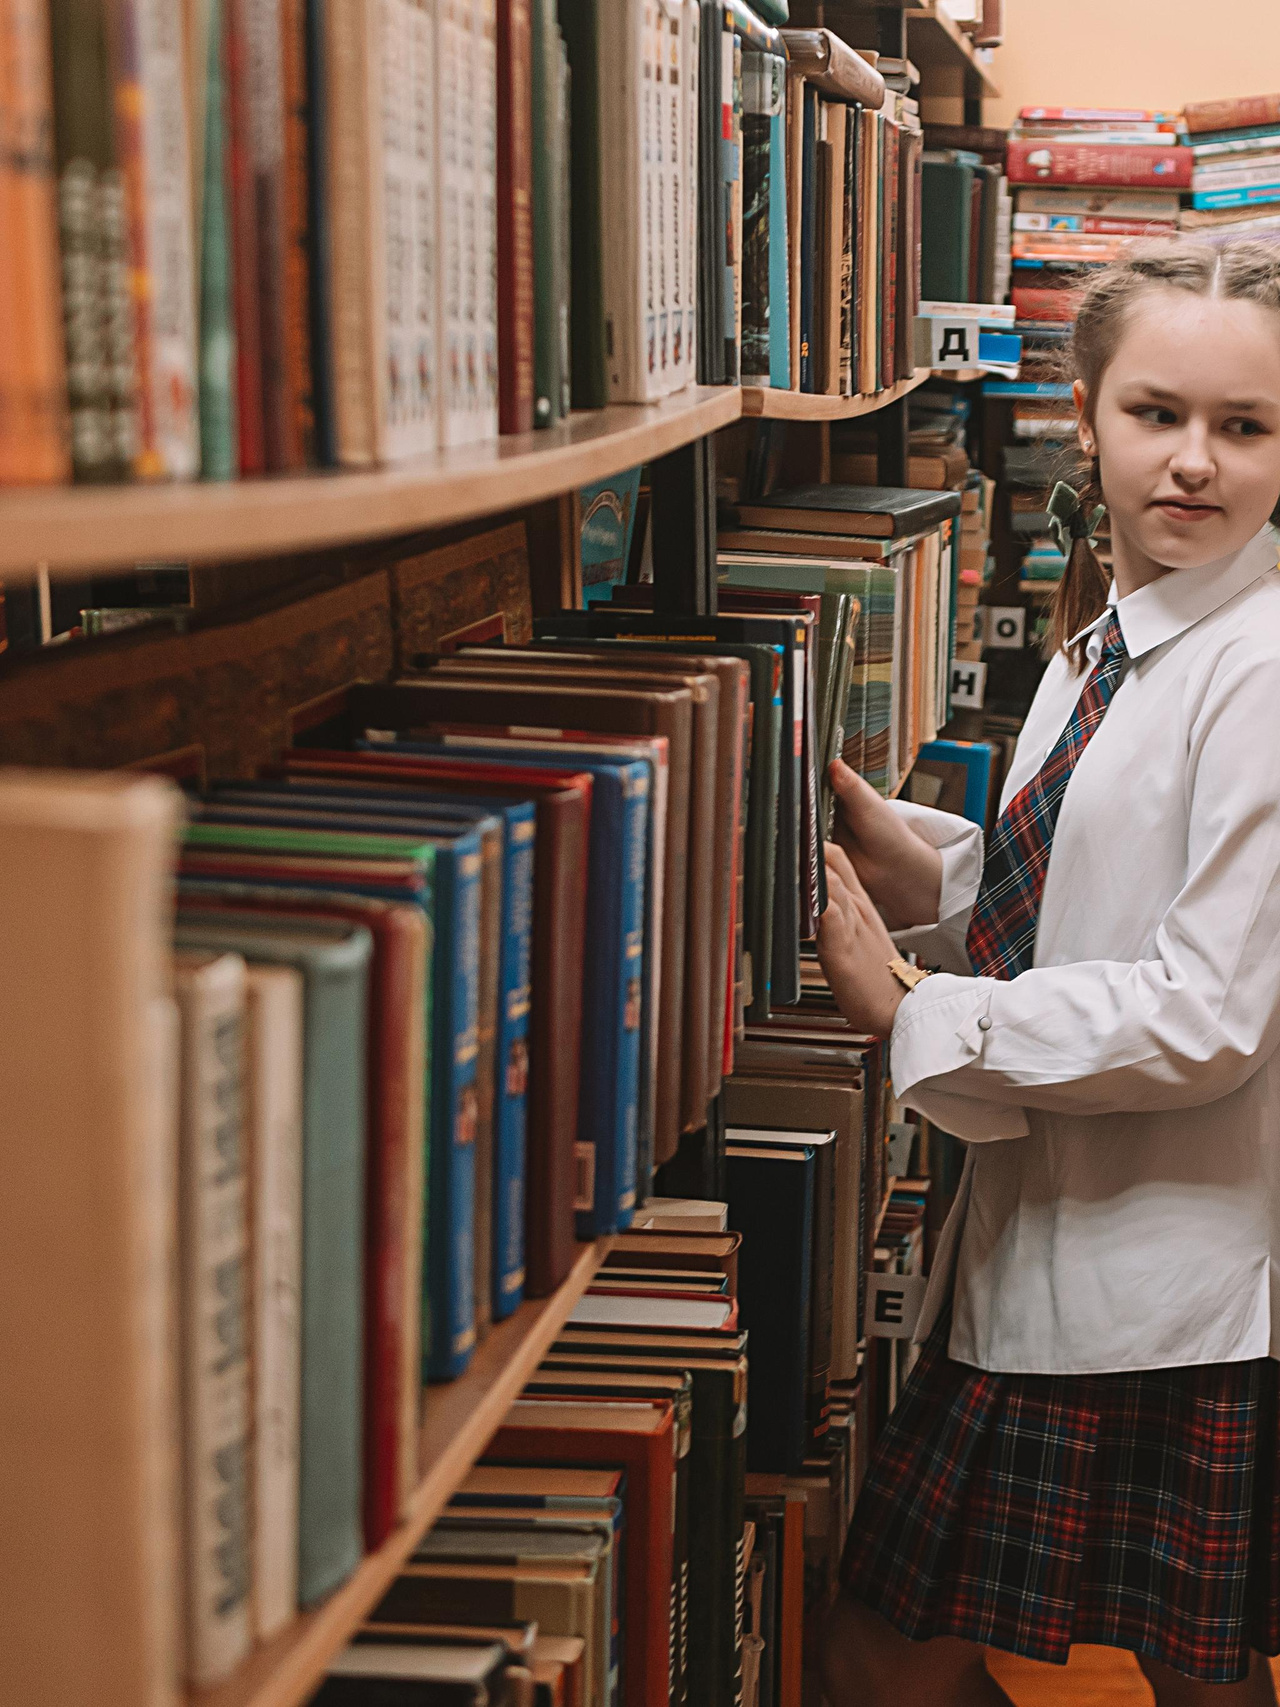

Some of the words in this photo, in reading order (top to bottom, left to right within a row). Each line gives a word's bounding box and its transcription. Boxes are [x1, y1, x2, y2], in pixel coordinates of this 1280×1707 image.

[938, 327, 969, 362] Д
[996, 617, 1016, 638] О
[953, 670, 975, 697] Н
[875, 1290, 903, 1323] Е
